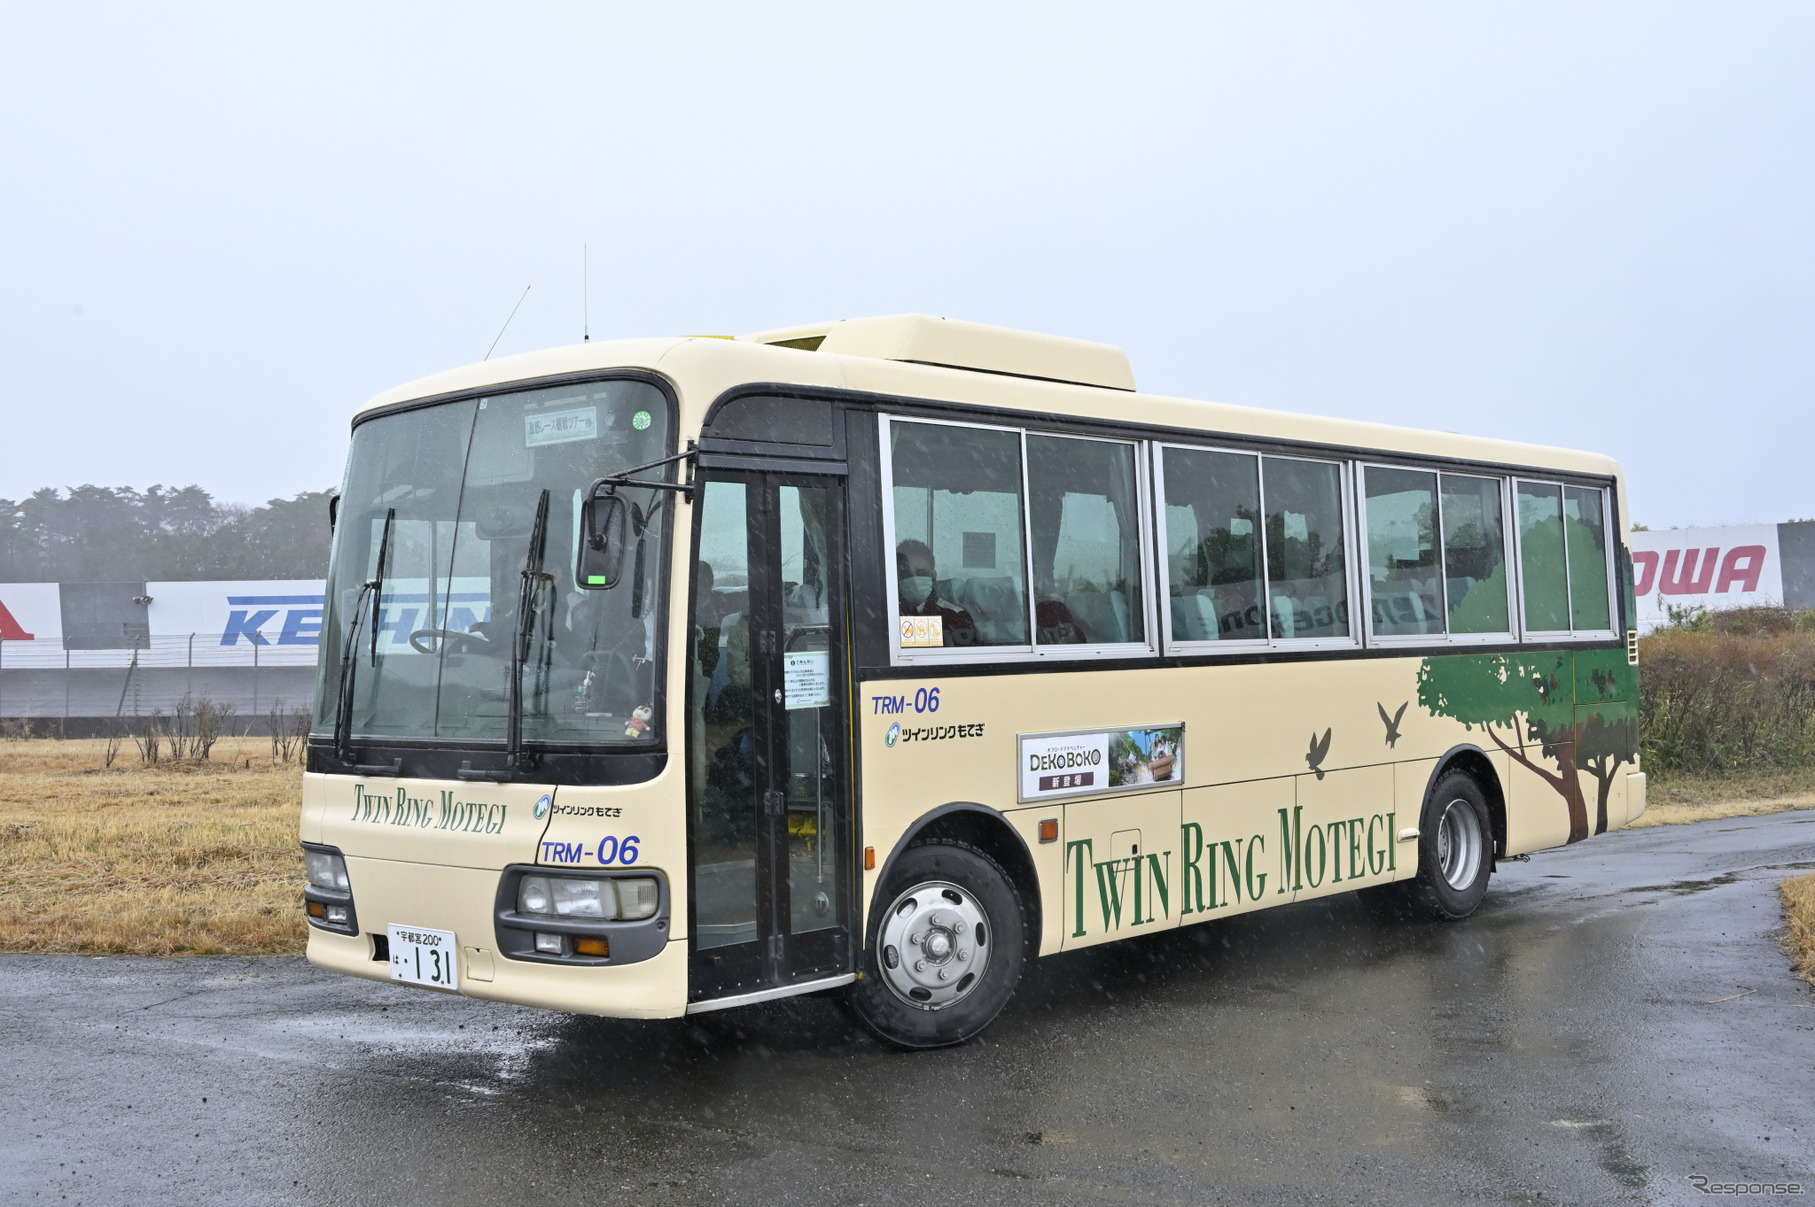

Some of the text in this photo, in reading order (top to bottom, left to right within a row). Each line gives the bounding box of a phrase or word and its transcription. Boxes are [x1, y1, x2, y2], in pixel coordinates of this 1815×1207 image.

[872, 687, 940, 715] TRM-06
[1052, 775, 1082, 788] 新登場
[352, 783, 507, 835] TWIN RING MOTEGI
[541, 835, 640, 865] TRM-06
[1066, 805, 1397, 938] TWIN RING MOTEGI
